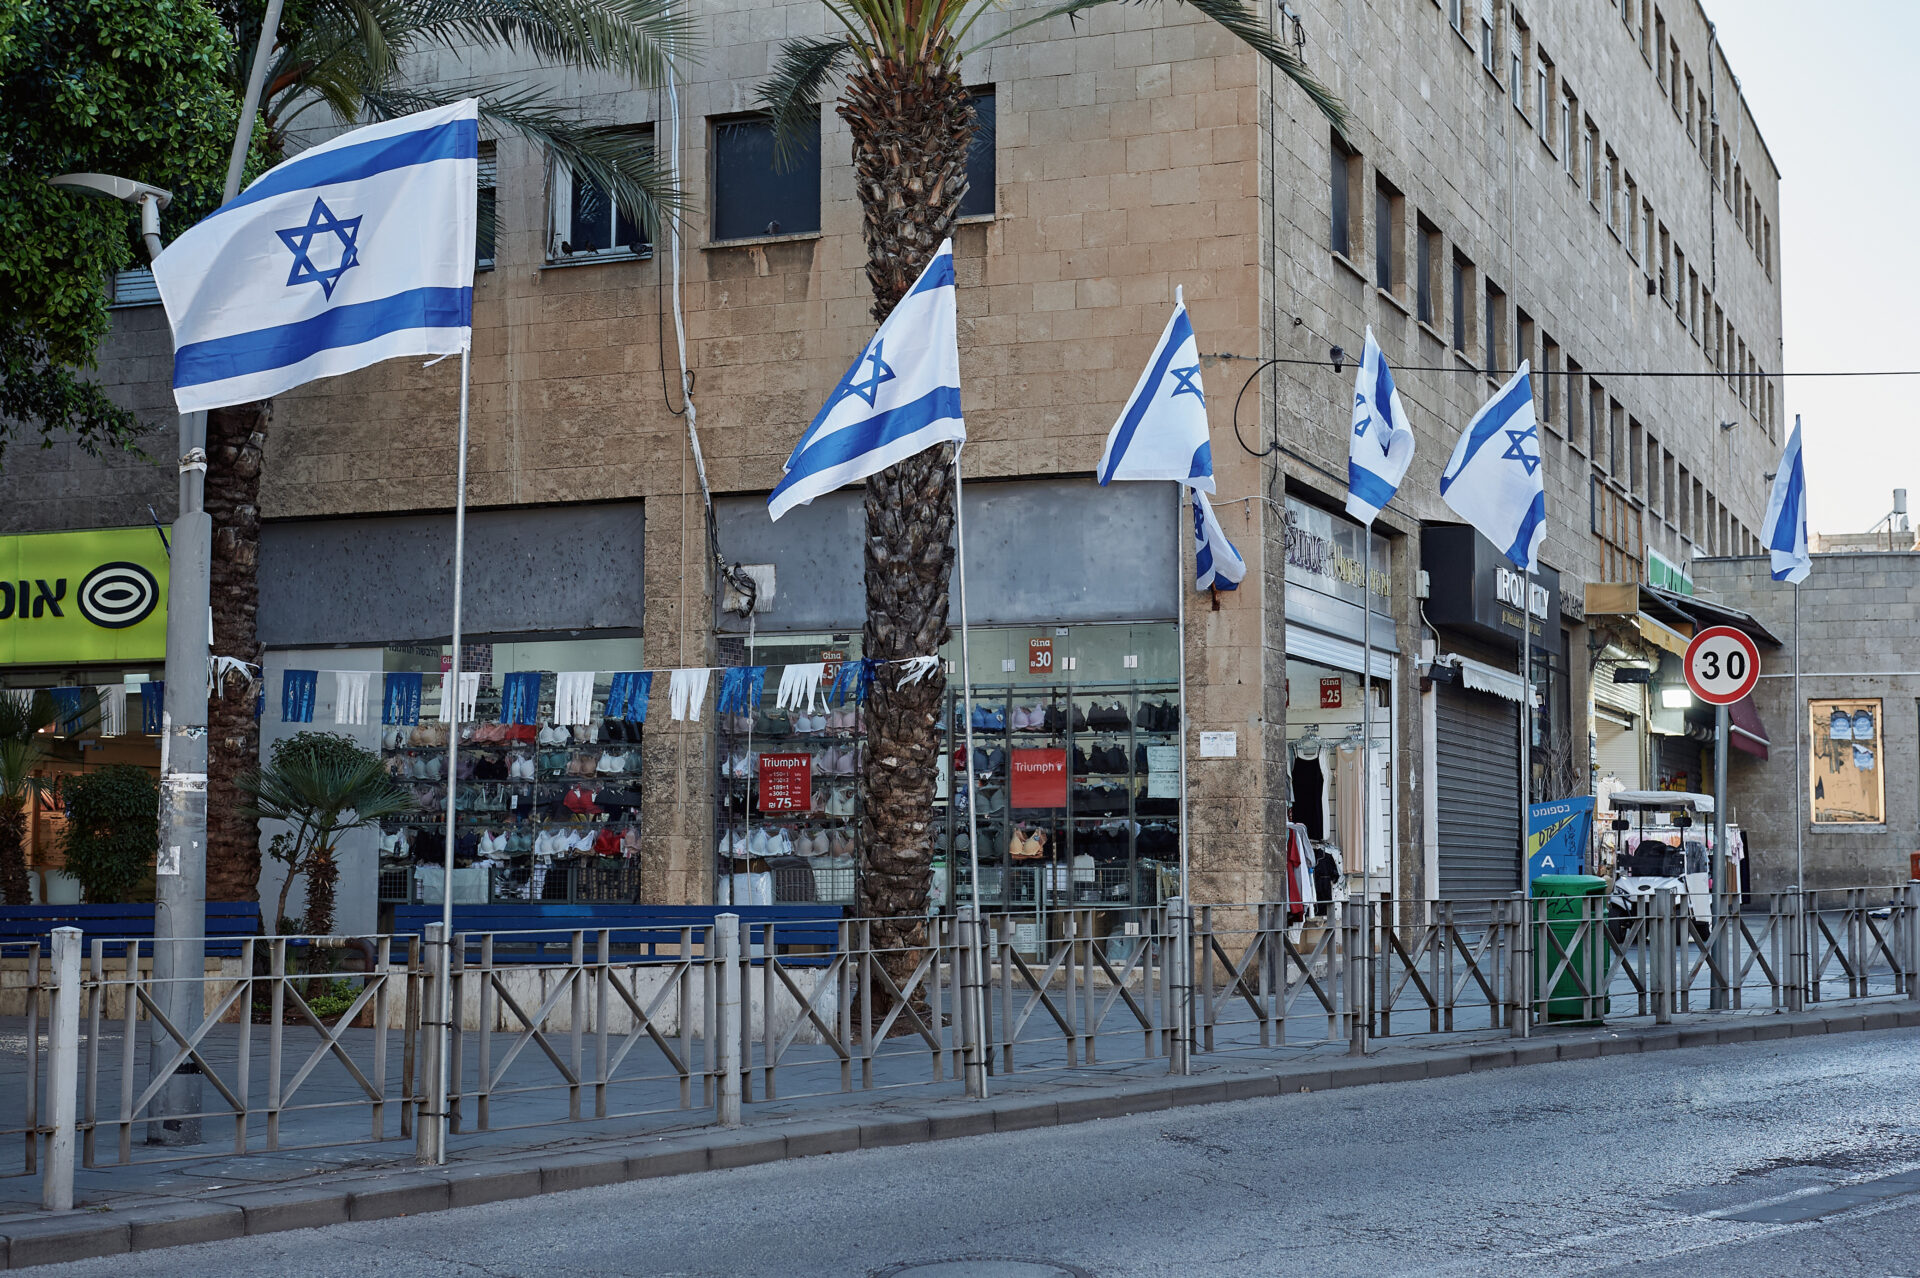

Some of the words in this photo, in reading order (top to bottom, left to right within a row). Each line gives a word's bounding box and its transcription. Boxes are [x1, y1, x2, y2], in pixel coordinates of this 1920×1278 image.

[822, 652, 841, 660] Gina
[1702, 651, 1745, 680] 30
[762, 757, 800, 769] Triumph
[1015, 762, 1055, 773] Triumph
[1532, 804, 1570, 817] כספומט
[1541, 855, 1555, 869] A
